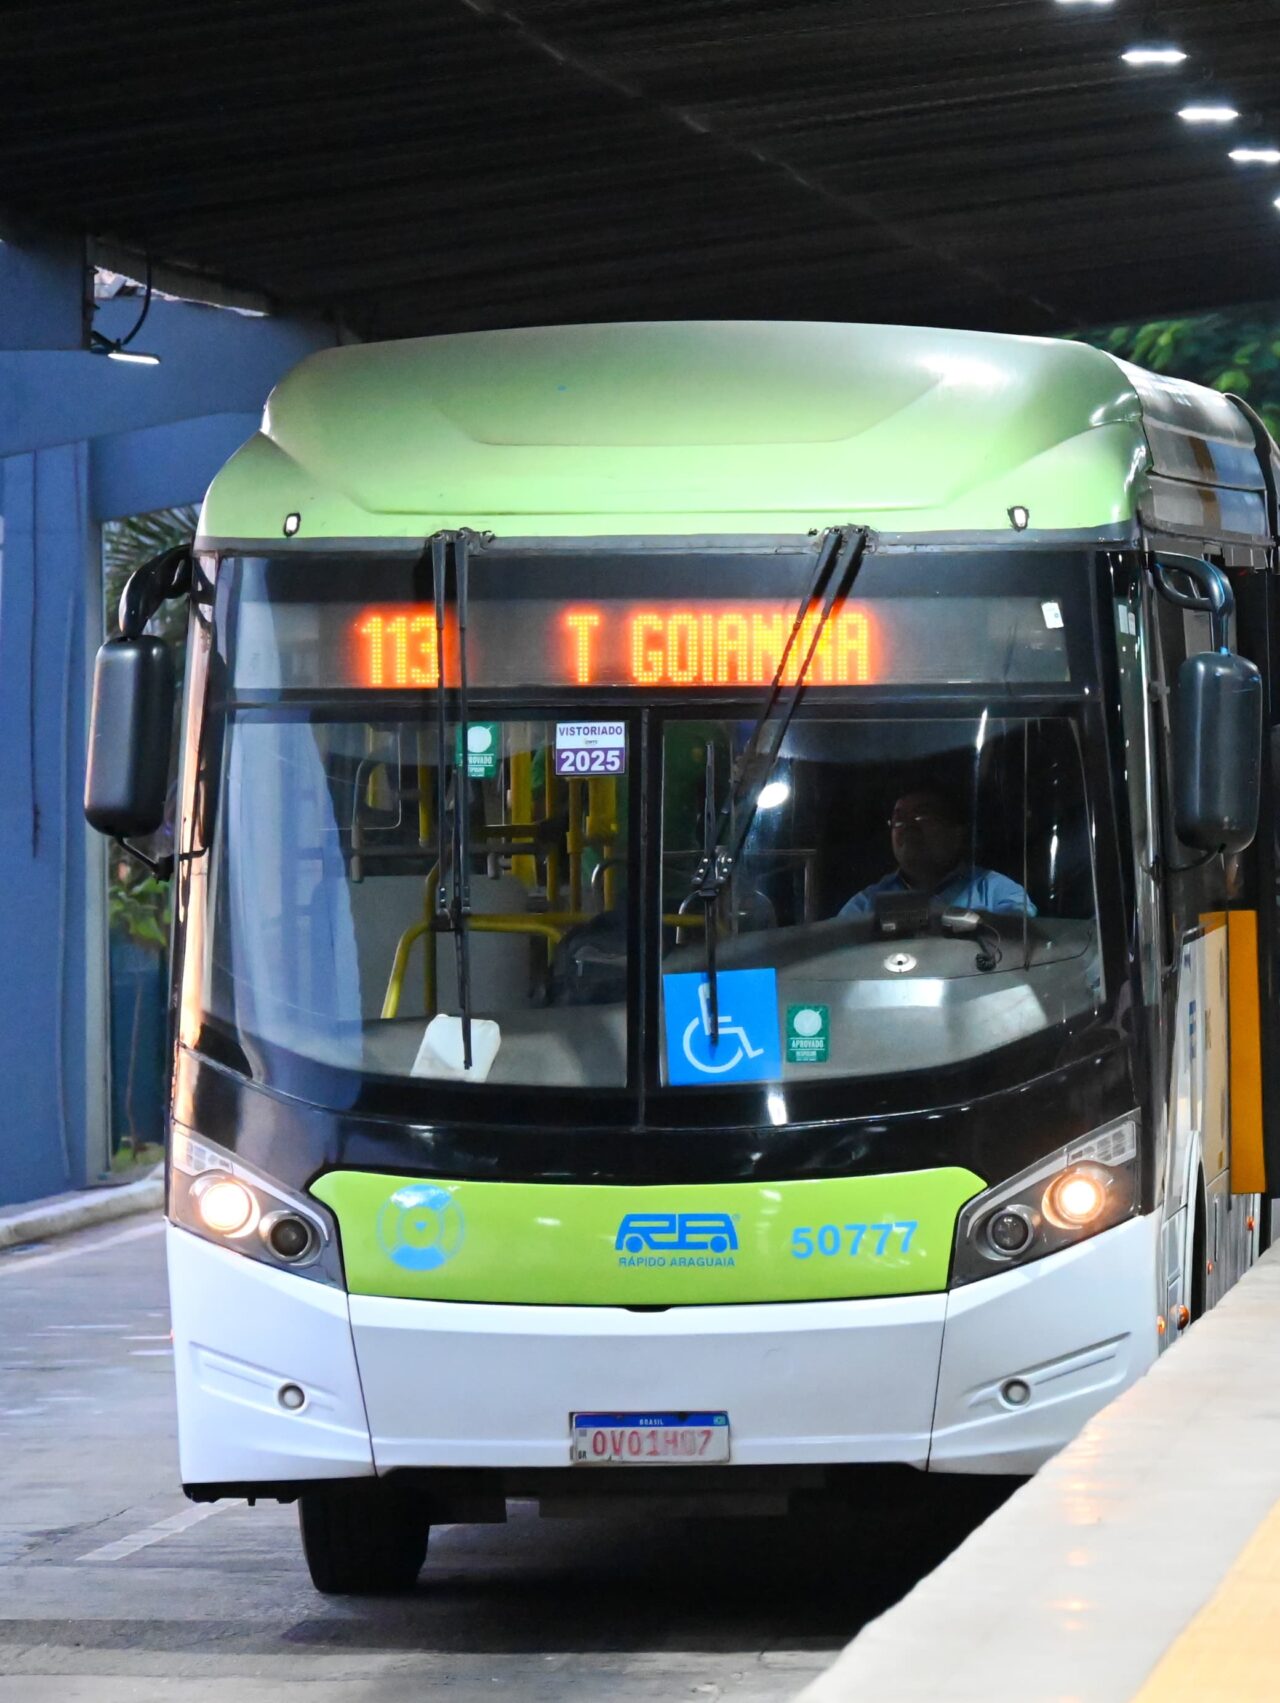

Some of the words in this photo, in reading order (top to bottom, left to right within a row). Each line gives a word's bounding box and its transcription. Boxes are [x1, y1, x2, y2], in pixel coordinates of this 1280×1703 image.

[362, 615, 440, 685] 113
[567, 614, 599, 683] T
[632, 612, 868, 683] GOIANIRA
[559, 726, 623, 737] VISTORIADO
[560, 750, 621, 772] 2025
[791, 1039, 824, 1048] APROVADO
[791, 1221, 918, 1259] 50777
[619, 1255, 666, 1268] RÁPIDO
[670, 1256, 736, 1267] ARAGUAIA
